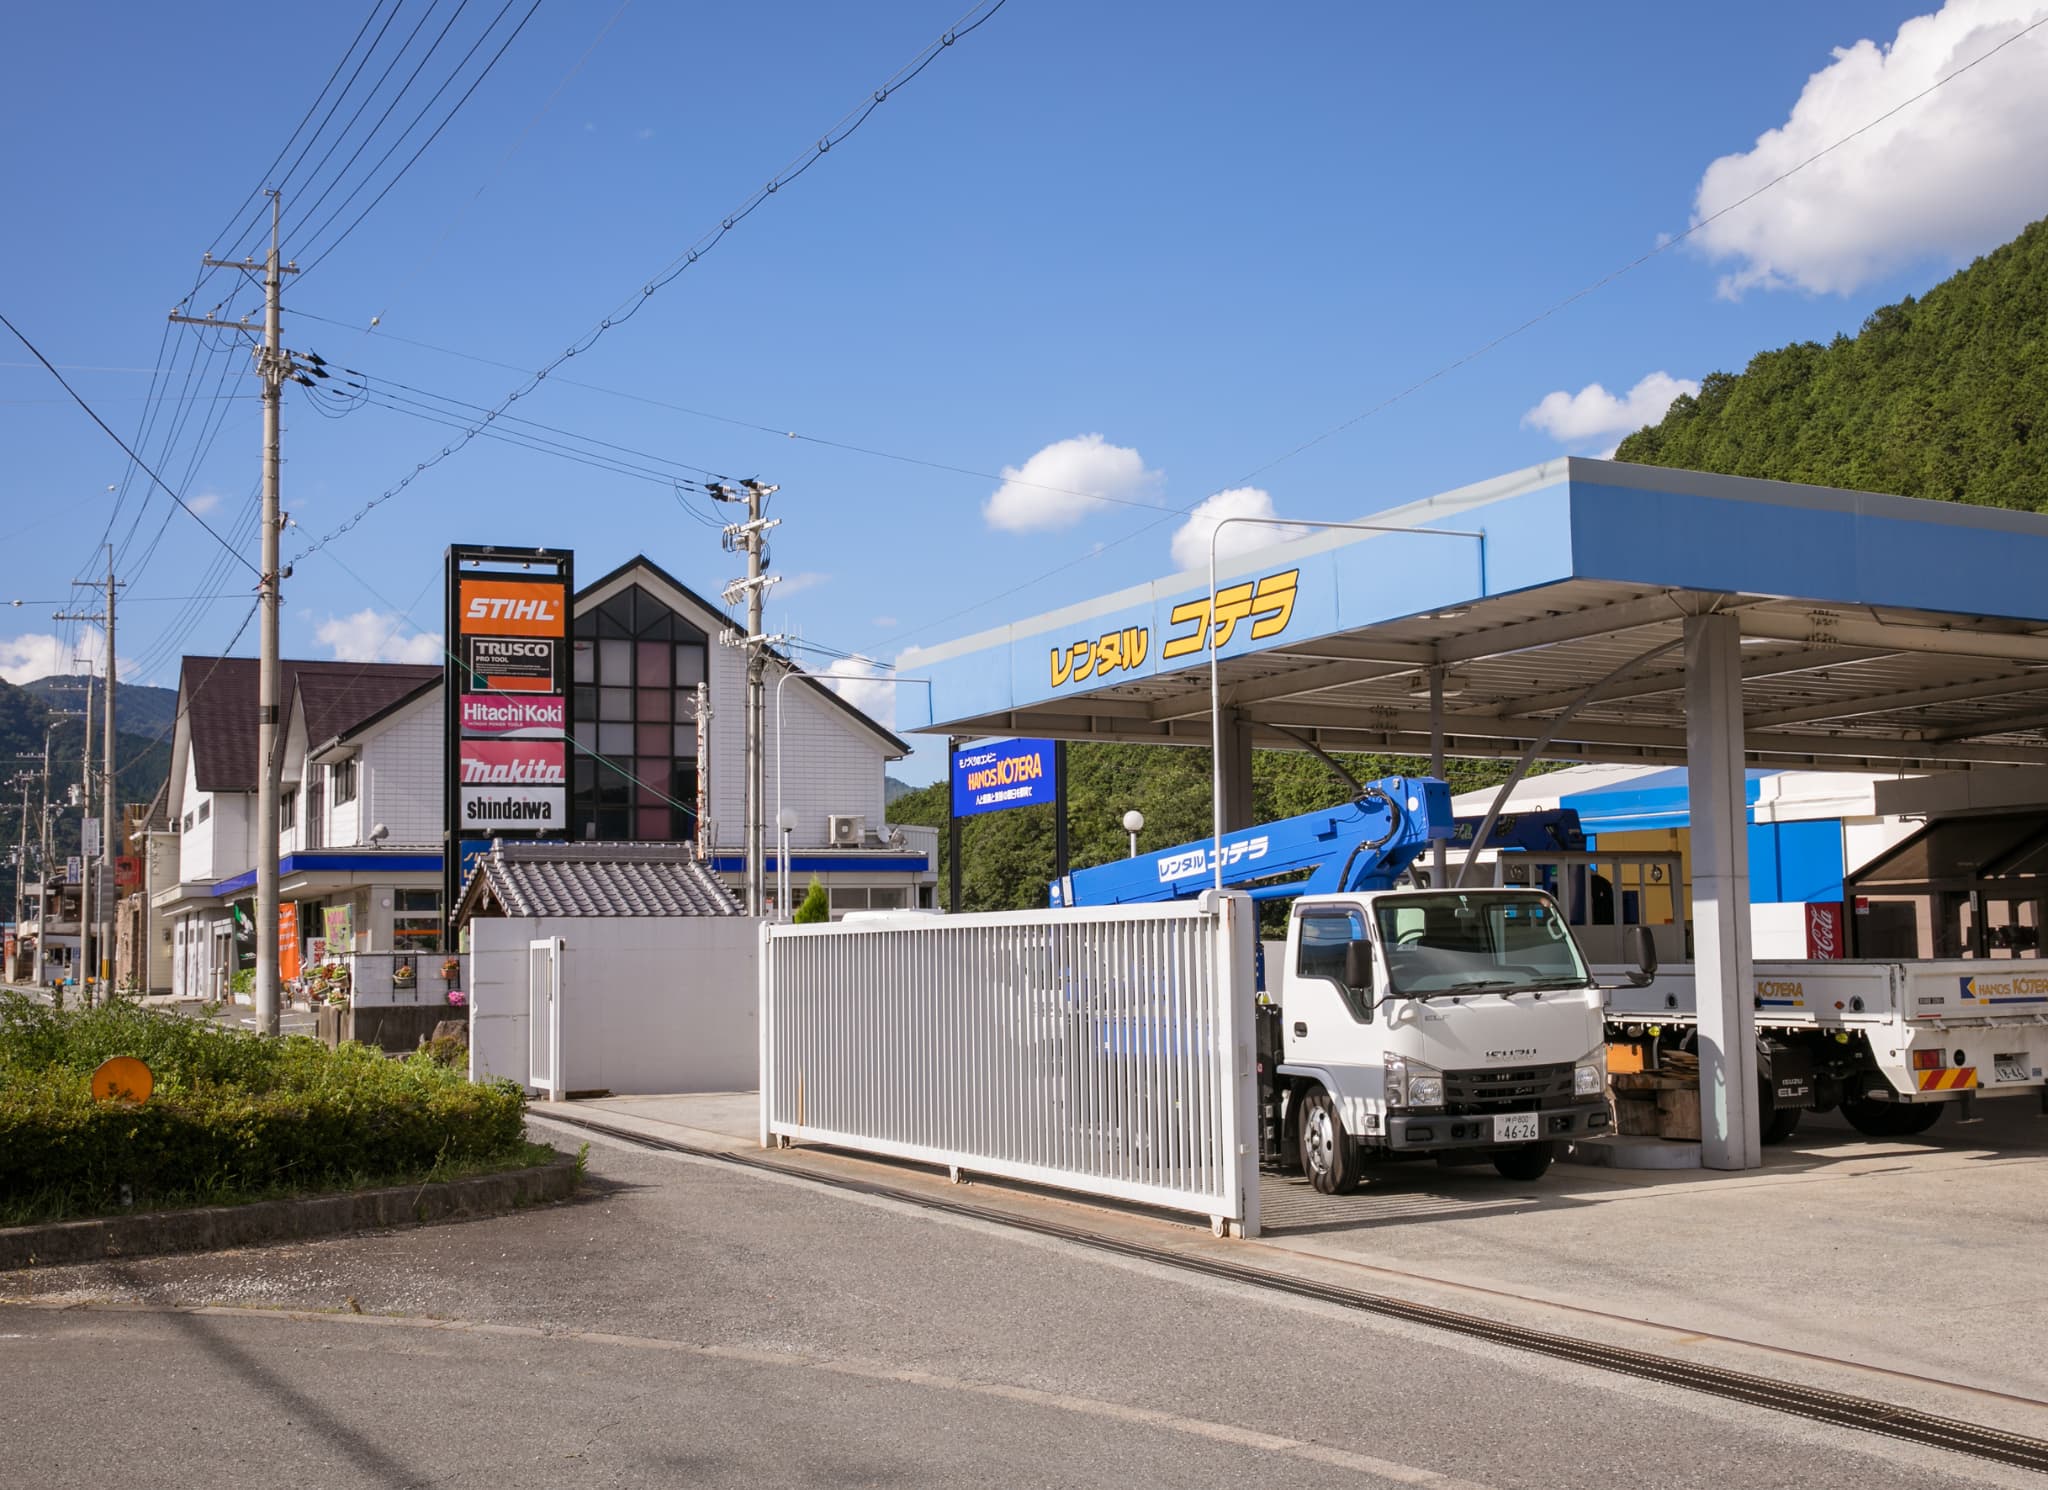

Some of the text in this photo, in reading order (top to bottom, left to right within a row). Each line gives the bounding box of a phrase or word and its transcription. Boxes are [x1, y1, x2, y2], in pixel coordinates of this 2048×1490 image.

[466, 597, 555, 621] STIHL
[1051, 568, 1300, 688] レンタル コテラ
[475, 642, 550, 658] TRUSCO
[491, 656, 509, 664] TOOL
[464, 703, 562, 722] Hitachi Koki
[997, 753, 1043, 785] KOTERA
[467, 796, 552, 820] shindaiwa
[1160, 835, 1269, 877] レンタル コテラ
[1757, 981, 1804, 997] KOTERA
[1778, 1087, 1809, 1097] ELF
